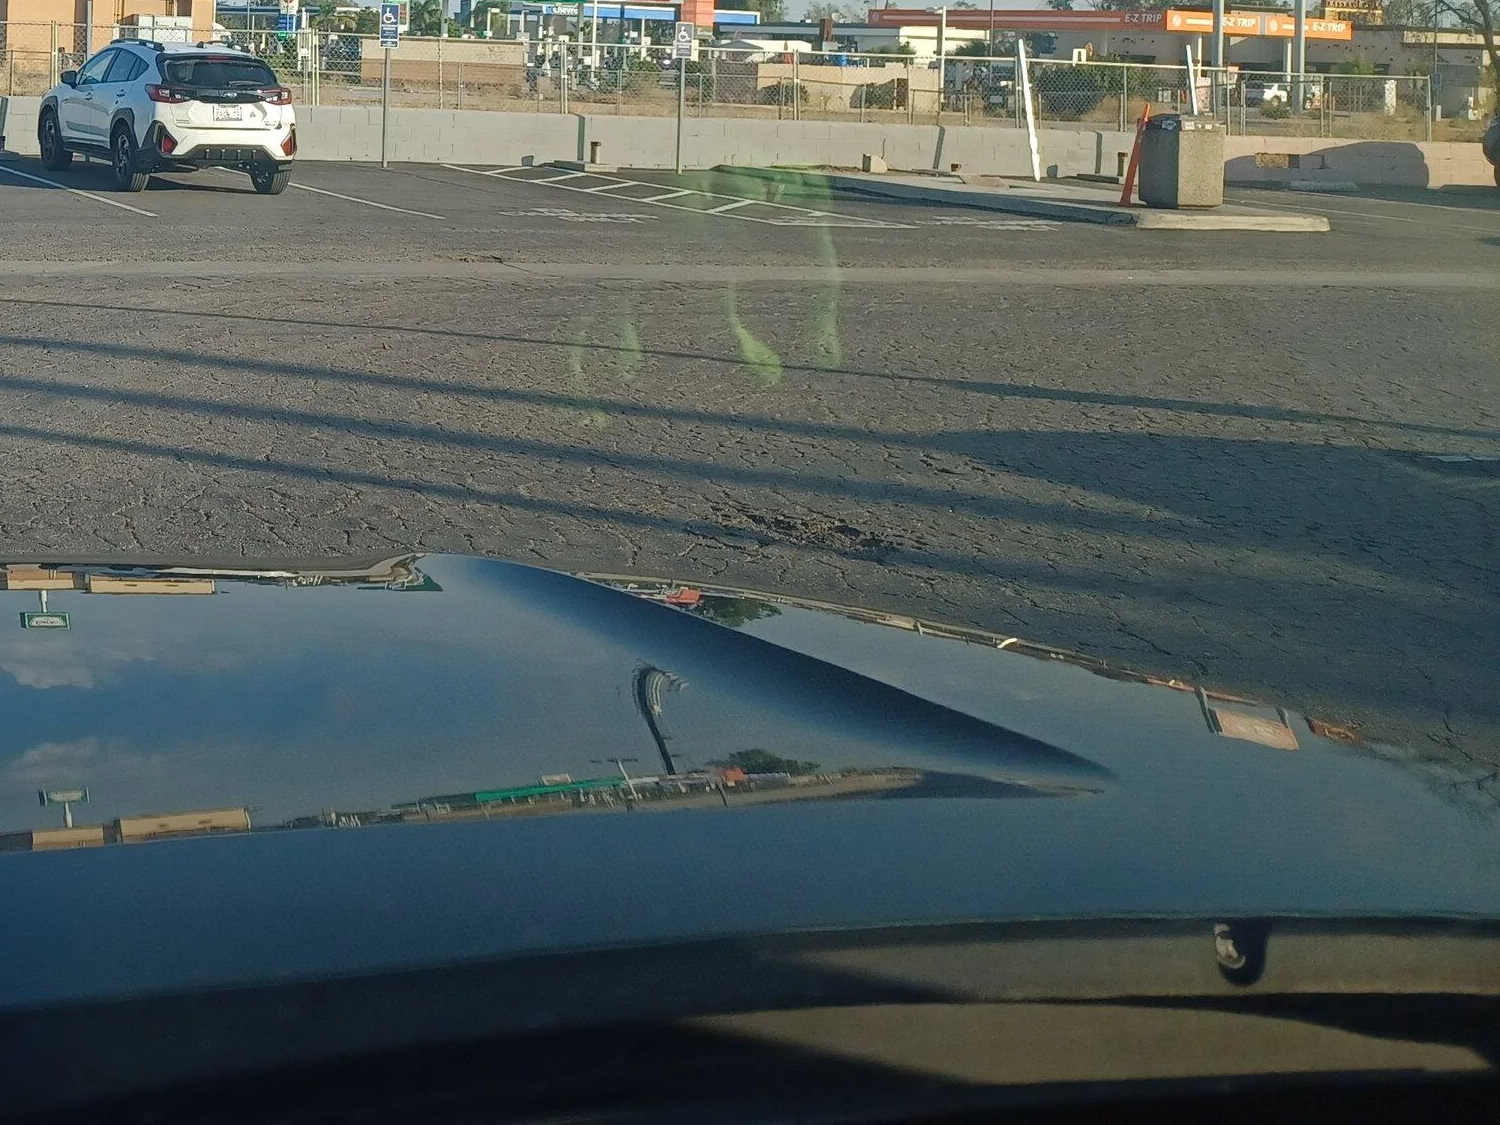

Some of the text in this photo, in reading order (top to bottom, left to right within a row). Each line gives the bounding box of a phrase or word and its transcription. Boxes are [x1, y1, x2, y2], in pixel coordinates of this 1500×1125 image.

[1124, 14, 1163, 23] E-Z TRIP
[1237, 17, 1257, 28] TRIP
[1326, 22, 1347, 33] TRIP
